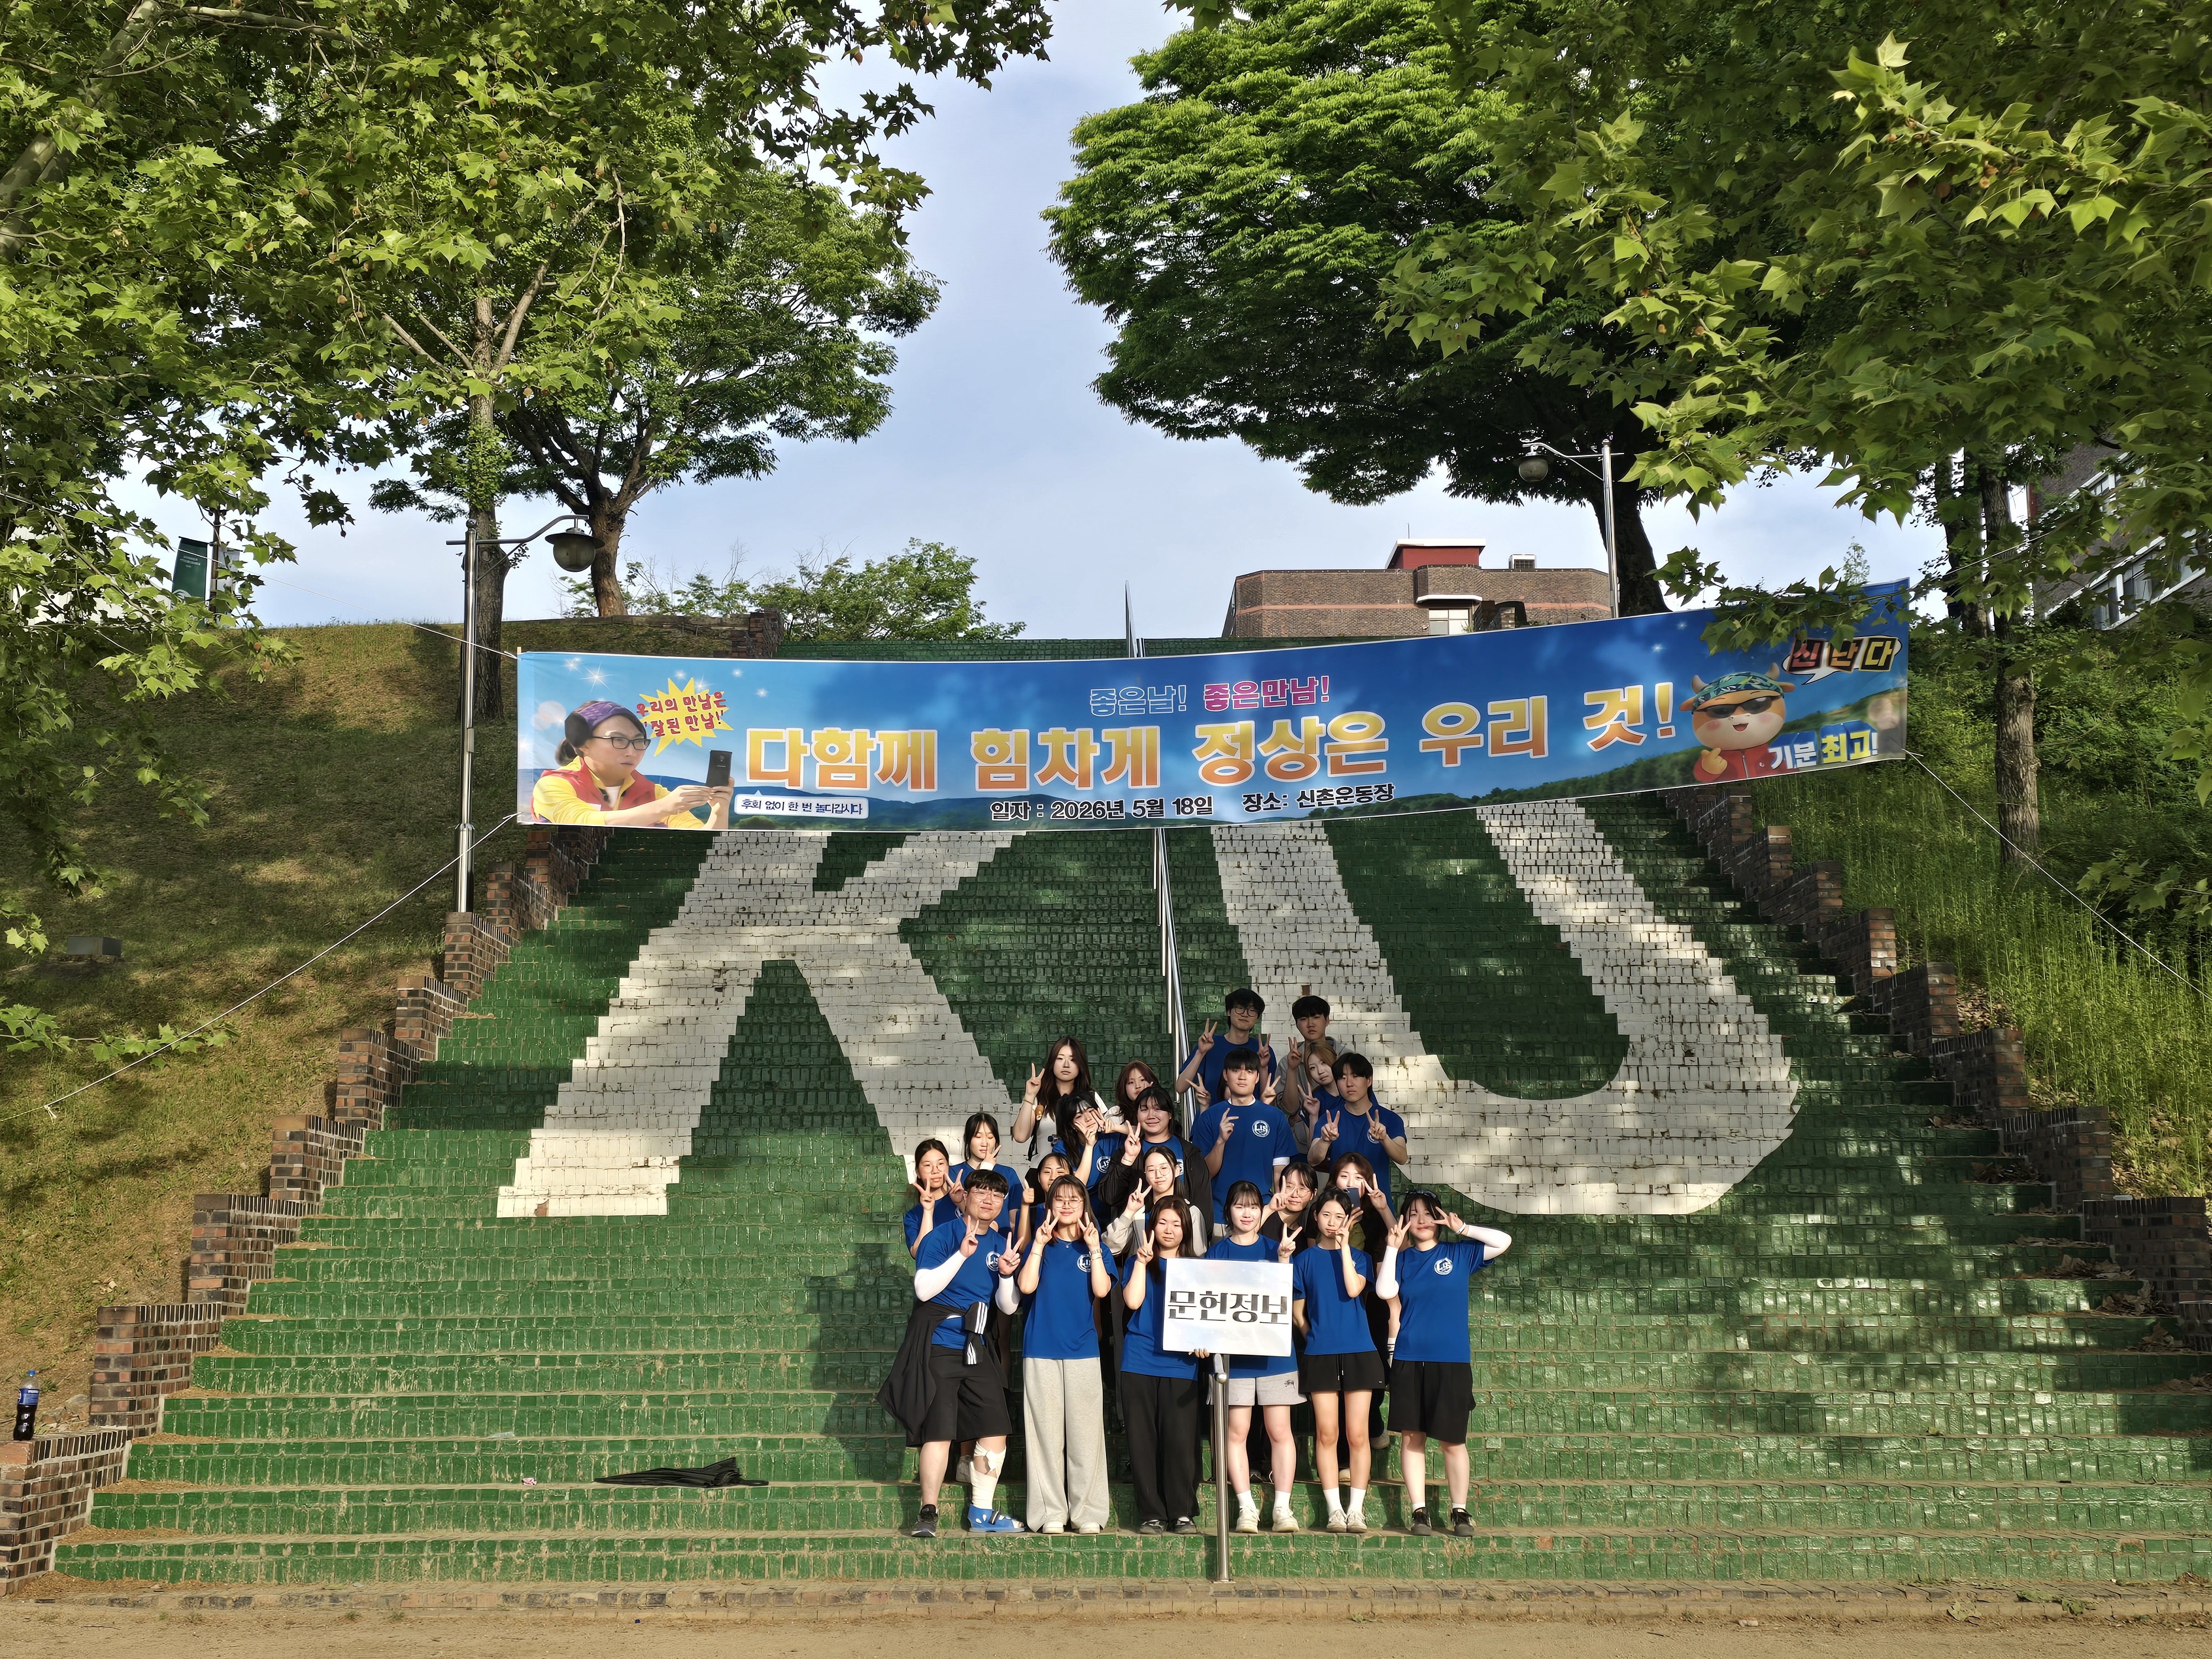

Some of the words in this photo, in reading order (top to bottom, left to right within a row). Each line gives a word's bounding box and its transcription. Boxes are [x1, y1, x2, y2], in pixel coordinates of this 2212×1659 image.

[1792, 640, 1892, 667] 신난다
[637, 698, 678, 717] 우리의
[683, 691, 726, 712] 만남은
[1090, 685, 1187, 717] 좋은날!
[1203, 676, 1330, 712] 좋은만남!
[746, 728, 938, 791] 다함께
[971, 726, 1160, 791] 힘차게
[1192, 711, 1389, 786] 정상은
[1420, 695, 1548, 768] 우리
[1584, 682, 1676, 752] 것!
[1768, 741, 1817, 769] 기분
[1822, 729, 1878, 763] 최고!
[741, 799, 761, 810] 후회
[765, 801, 785, 811] 없이
[788, 801, 799, 811] 한
[802, 802, 812, 812] 번
[990, 801, 1031, 821] 일자
[1050, 800, 1125, 820] 2026년
[1133, 798, 1165, 818] 5월
[1171, 795, 1213, 816] 18일
[1242, 792, 1289, 813] 장소:
[1296, 782, 1395, 809] 신촌운동장
[1167, 1291, 1290, 1324] 문헌정보
